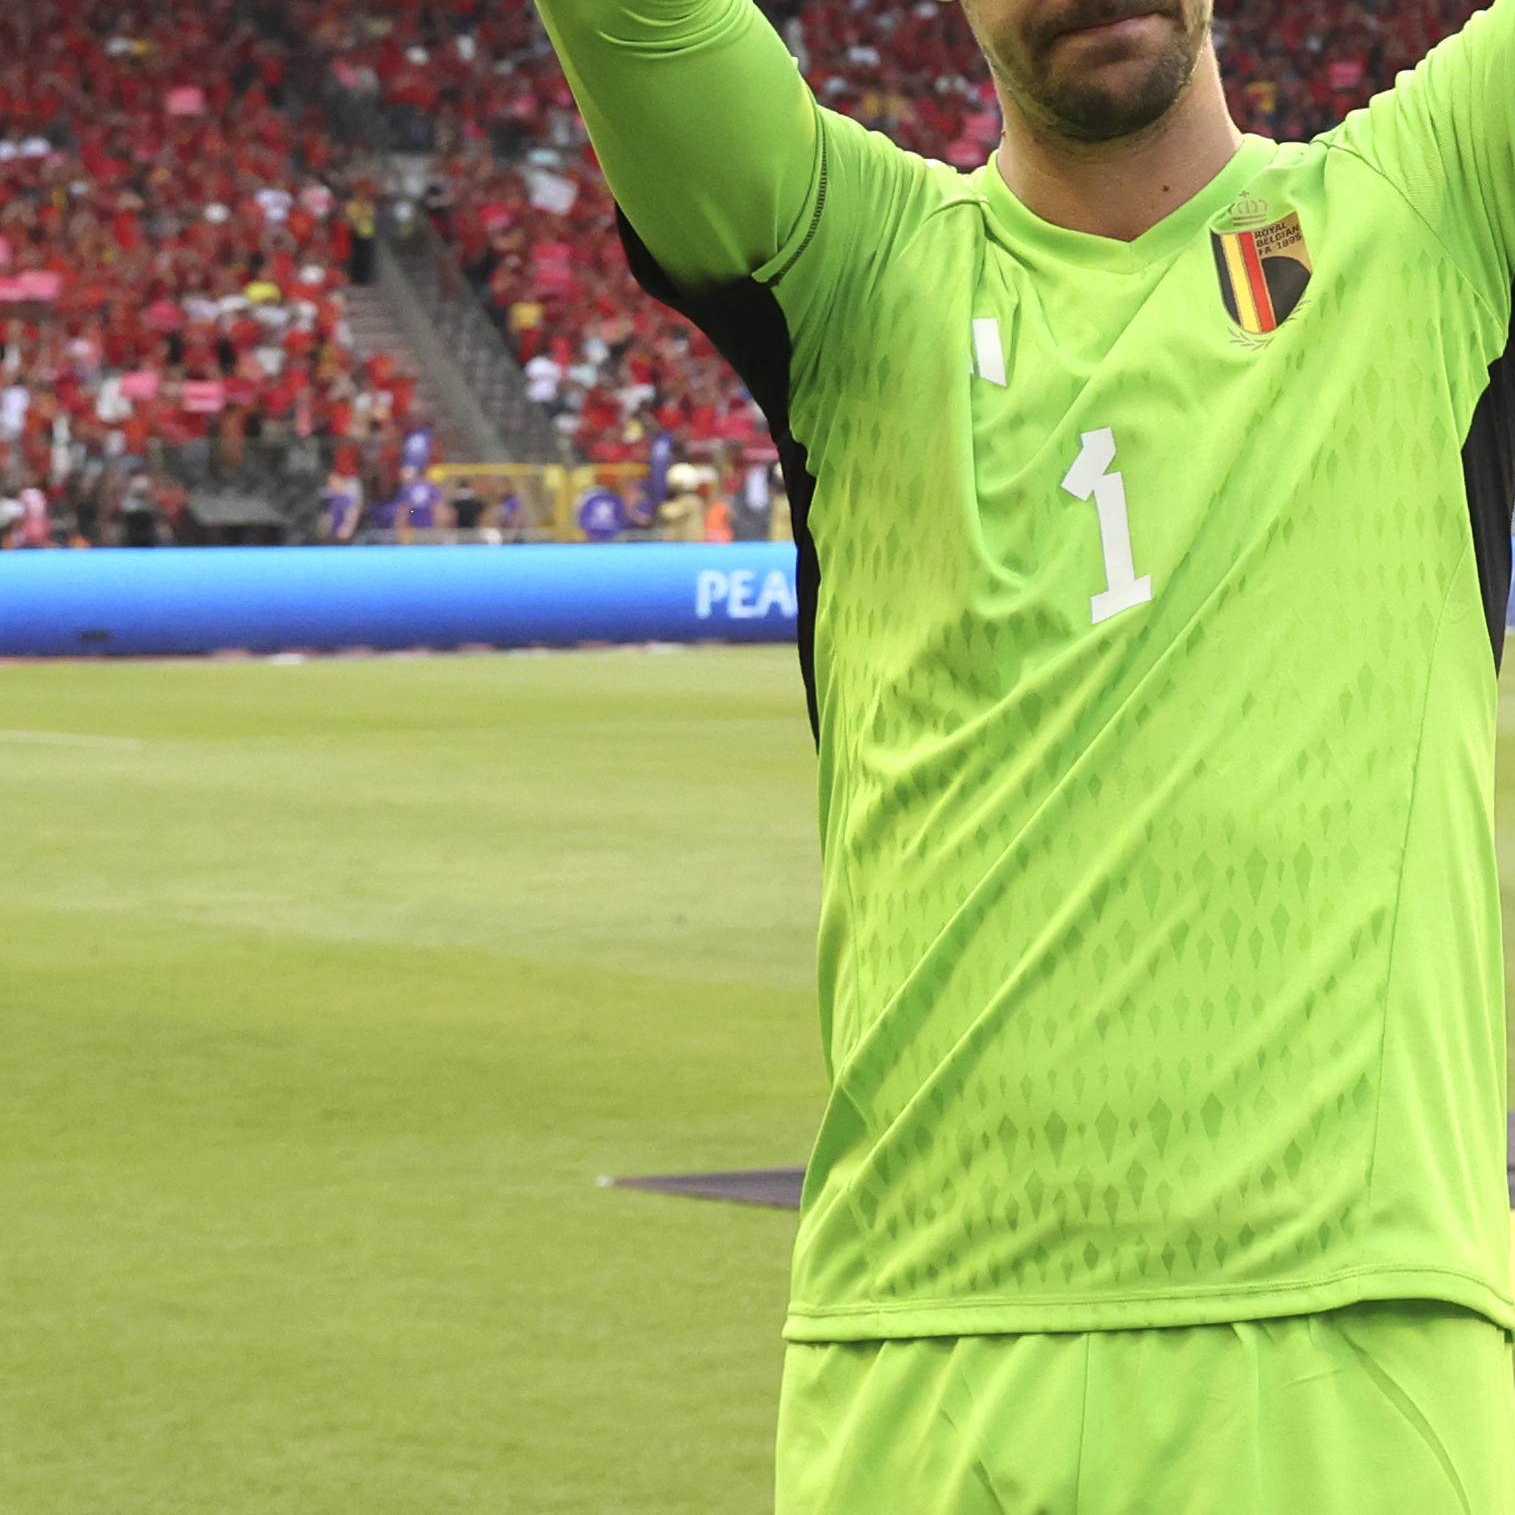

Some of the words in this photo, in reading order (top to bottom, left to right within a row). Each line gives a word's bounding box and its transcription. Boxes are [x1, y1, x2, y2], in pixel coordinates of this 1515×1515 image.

[1254, 222, 1286, 239] ROYAL
[1256, 224, 1300, 247] BELGIAN
[1258, 246, 1272, 256] FA
[1061, 427, 1152, 624] 1
[695, 570, 798, 619] PEA
